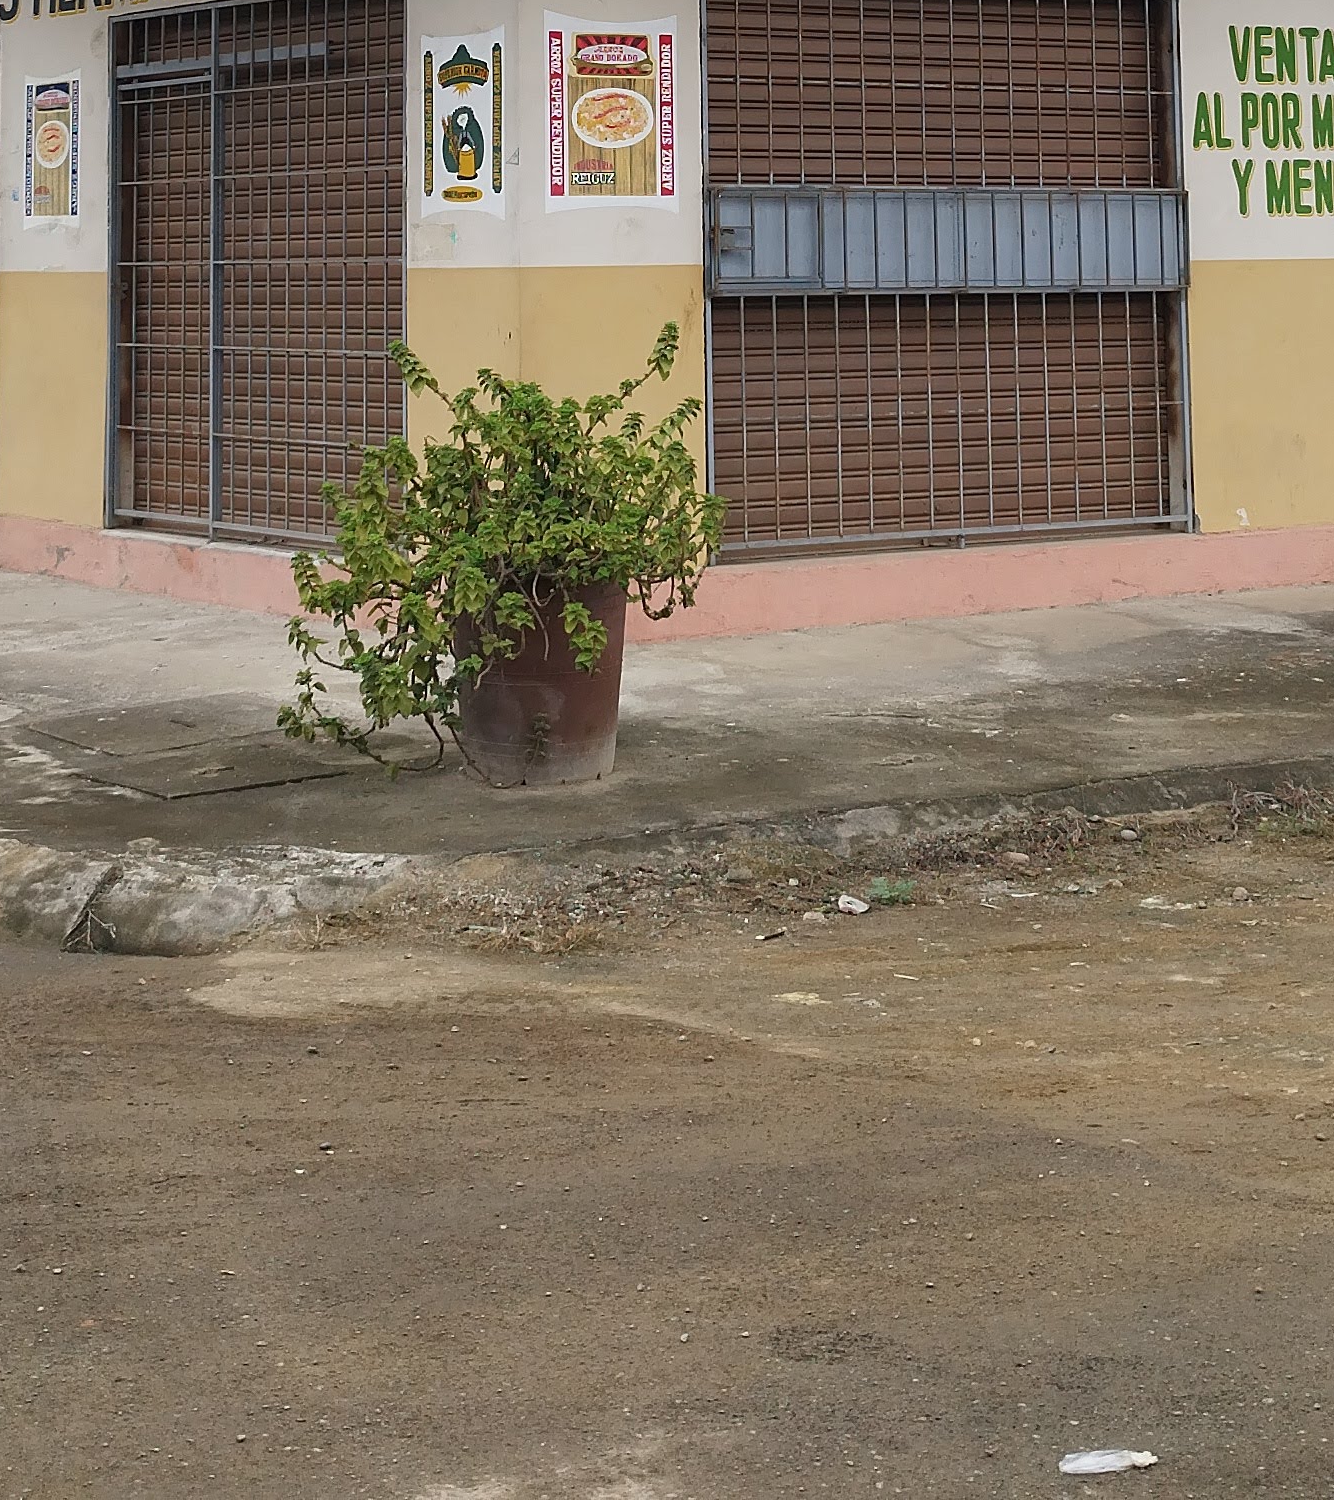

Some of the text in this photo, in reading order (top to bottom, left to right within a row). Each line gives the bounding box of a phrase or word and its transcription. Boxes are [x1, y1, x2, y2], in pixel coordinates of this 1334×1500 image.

[549, 36, 564, 186] ARROZ SUPER RENDIDOR
[660, 43, 673, 191] ARROZ SUPER RENDIDOR
[1191, 92, 1235, 151] AL
[1240, 91, 1303, 152] POR
[571, 171, 616, 186] REIGUZ
[573, 158, 614, 172] INDUSTRIA
[1230, 158, 1259, 217] Y
